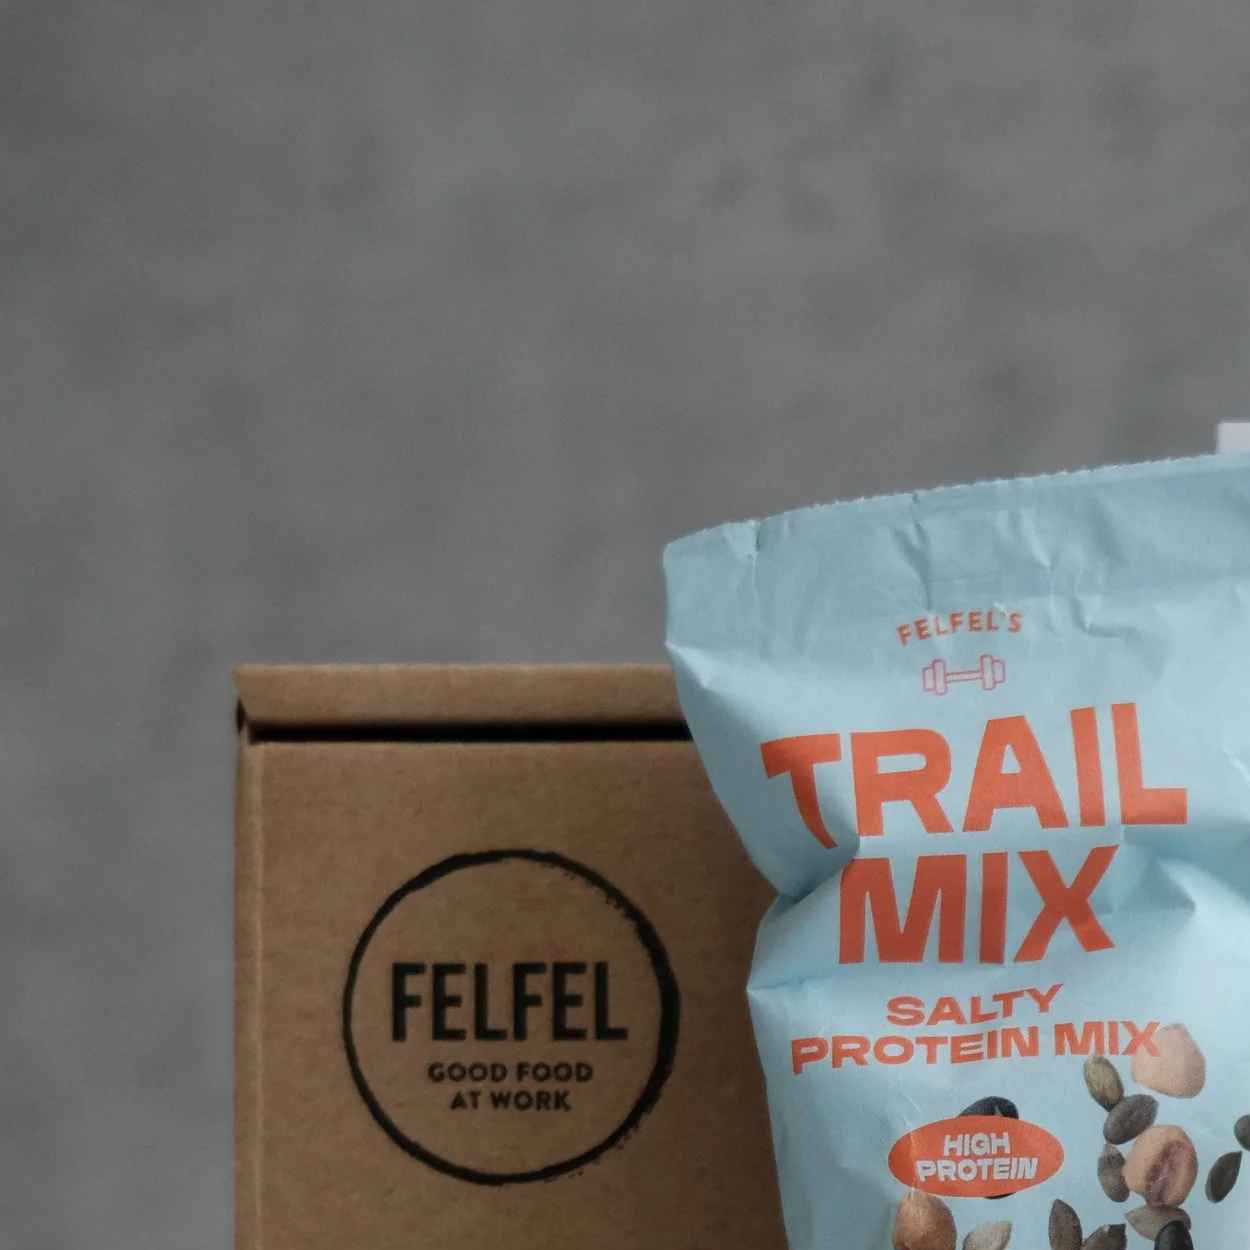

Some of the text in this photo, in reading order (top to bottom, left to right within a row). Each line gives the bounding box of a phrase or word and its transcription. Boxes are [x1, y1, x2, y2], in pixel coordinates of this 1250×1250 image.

[896, 611, 1023, 648] FELFEL'S
[760, 702, 1188, 850] TRAIL
[838, 845, 1120, 965] MIX
[392, 962, 629, 1042] FELFEL
[886, 983, 1064, 1026] SALTY
[791, 1020, 1161, 1076] PROTEIN MIX
[428, 1062, 593, 1083] GOOD FOOD
[450, 1090, 573, 1111] AT WORK
[943, 1132, 1011, 1156] HIGH
[916, 1157, 1039, 1182] PROTEIN
